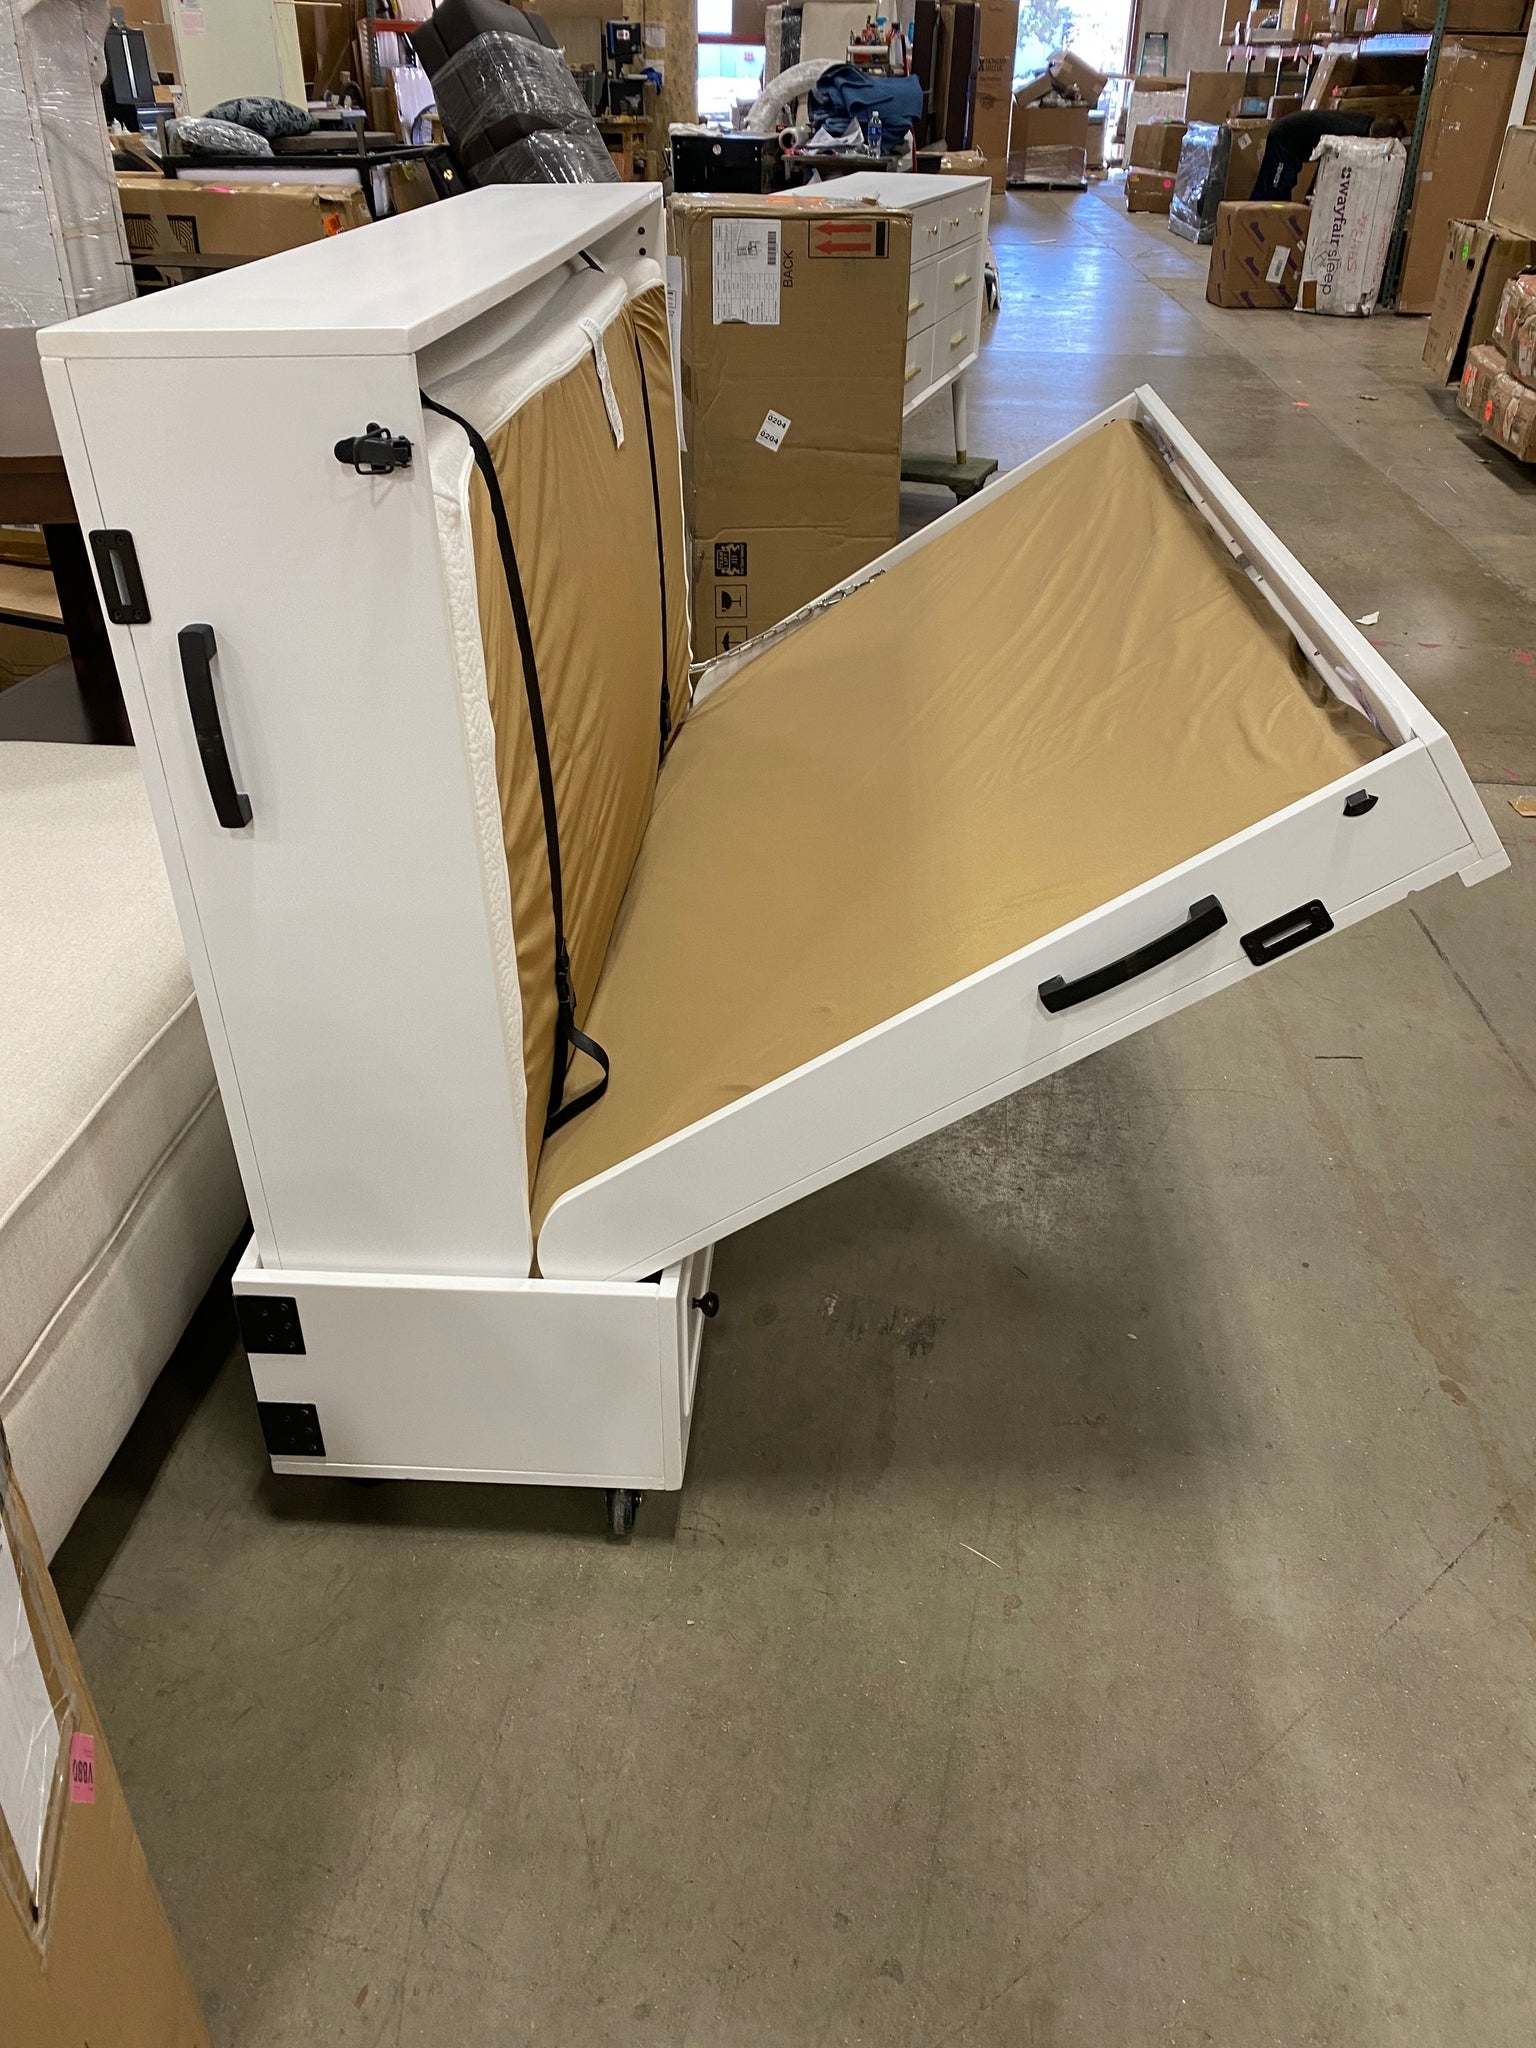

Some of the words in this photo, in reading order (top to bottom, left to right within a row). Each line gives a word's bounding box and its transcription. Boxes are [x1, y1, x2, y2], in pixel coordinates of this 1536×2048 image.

[1330, 181, 1352, 248] wayfair
[782, 249, 794, 288] BACK
[1319, 248, 1341, 295] sleep
[760, 430, 779, 445] 0204
[767, 414, 787, 429] 0204
